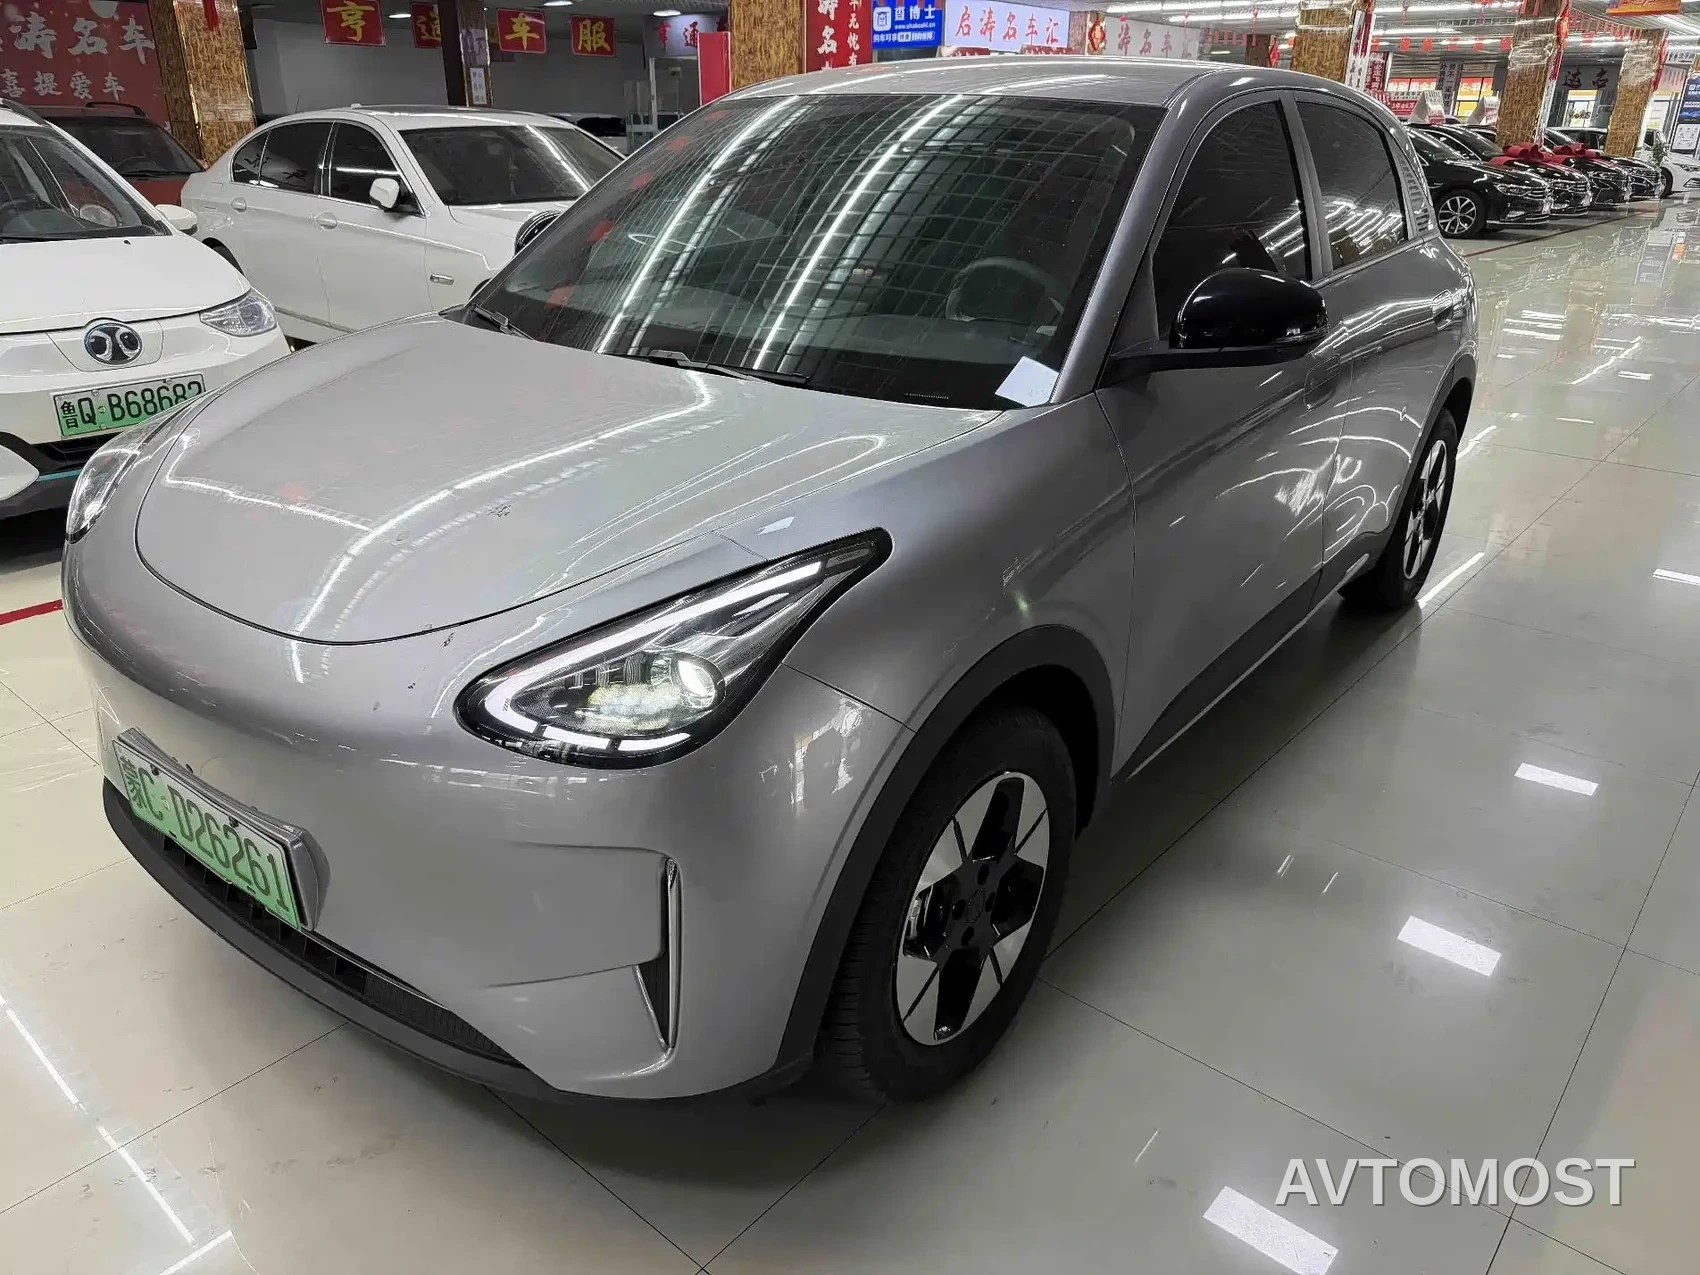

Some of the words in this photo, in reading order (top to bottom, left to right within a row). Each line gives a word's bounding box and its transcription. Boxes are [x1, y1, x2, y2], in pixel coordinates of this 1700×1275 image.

[0, 11, 155, 64] 涛名车
[1117, 22, 1192, 58] 涛名车汇
[1, 68, 125, 100] 喜提爱车
